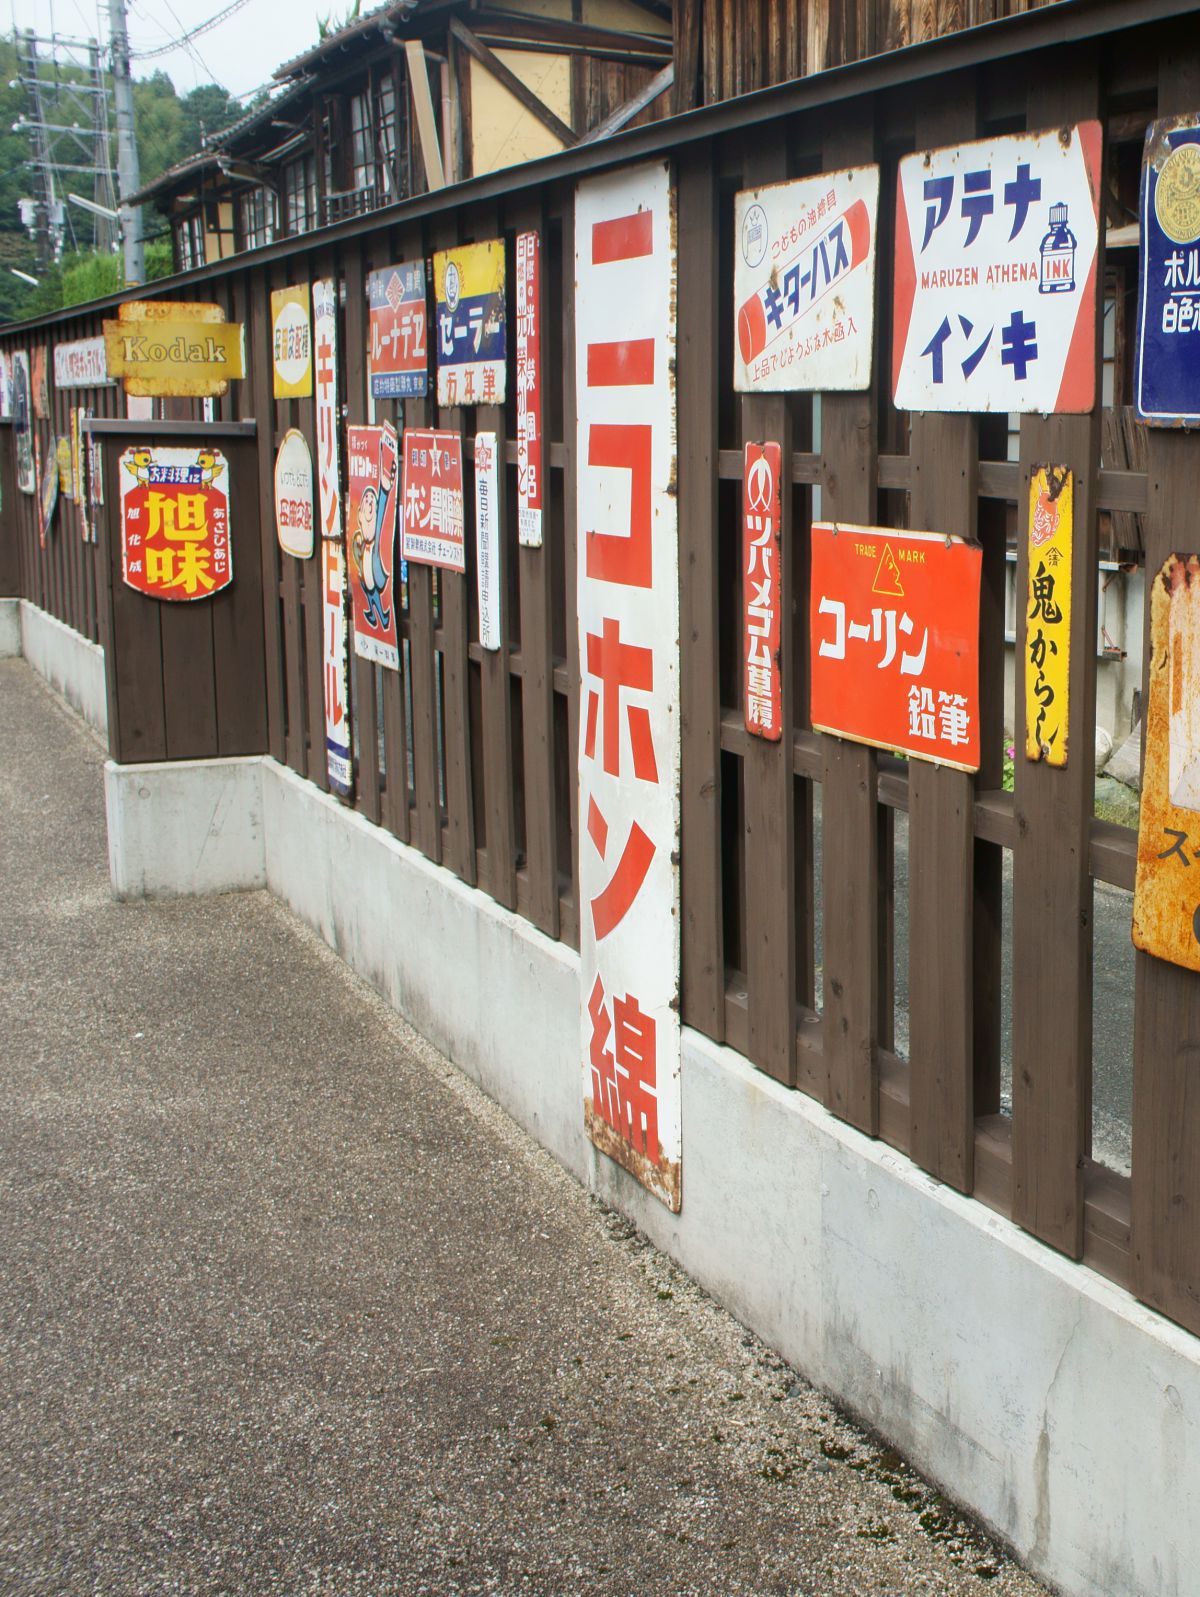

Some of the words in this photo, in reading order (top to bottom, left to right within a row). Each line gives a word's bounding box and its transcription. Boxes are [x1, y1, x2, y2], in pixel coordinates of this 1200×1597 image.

[920, 163, 1042, 255] アテナ
[921, 266, 979, 290] MARUZEN
[986, 262, 1038, 285] ATHENA
[1046, 257, 1070, 279] INK
[122, 335, 226, 363] Kodak
[439, 307, 500, 357] セーラー
[920, 310, 1038, 384] インキ
[446, 366, 496, 404] 万年筆
[150, 467, 200, 483] お料理に
[128, 507, 142, 573] 旭化成
[144, 491, 216, 594] 旭味
[213, 507, 226, 573] あさひあじ
[317, 334, 344, 726] キリンビール
[854, 543, 876, 559] TRADE
[898, 549, 926, 564] MARK
[747, 515, 774, 730] ツバメゴム草履
[819, 595, 928, 676] コーリン
[1029, 561, 1063, 747] 鬼からし
[907, 684, 971, 746] 鉛筆
